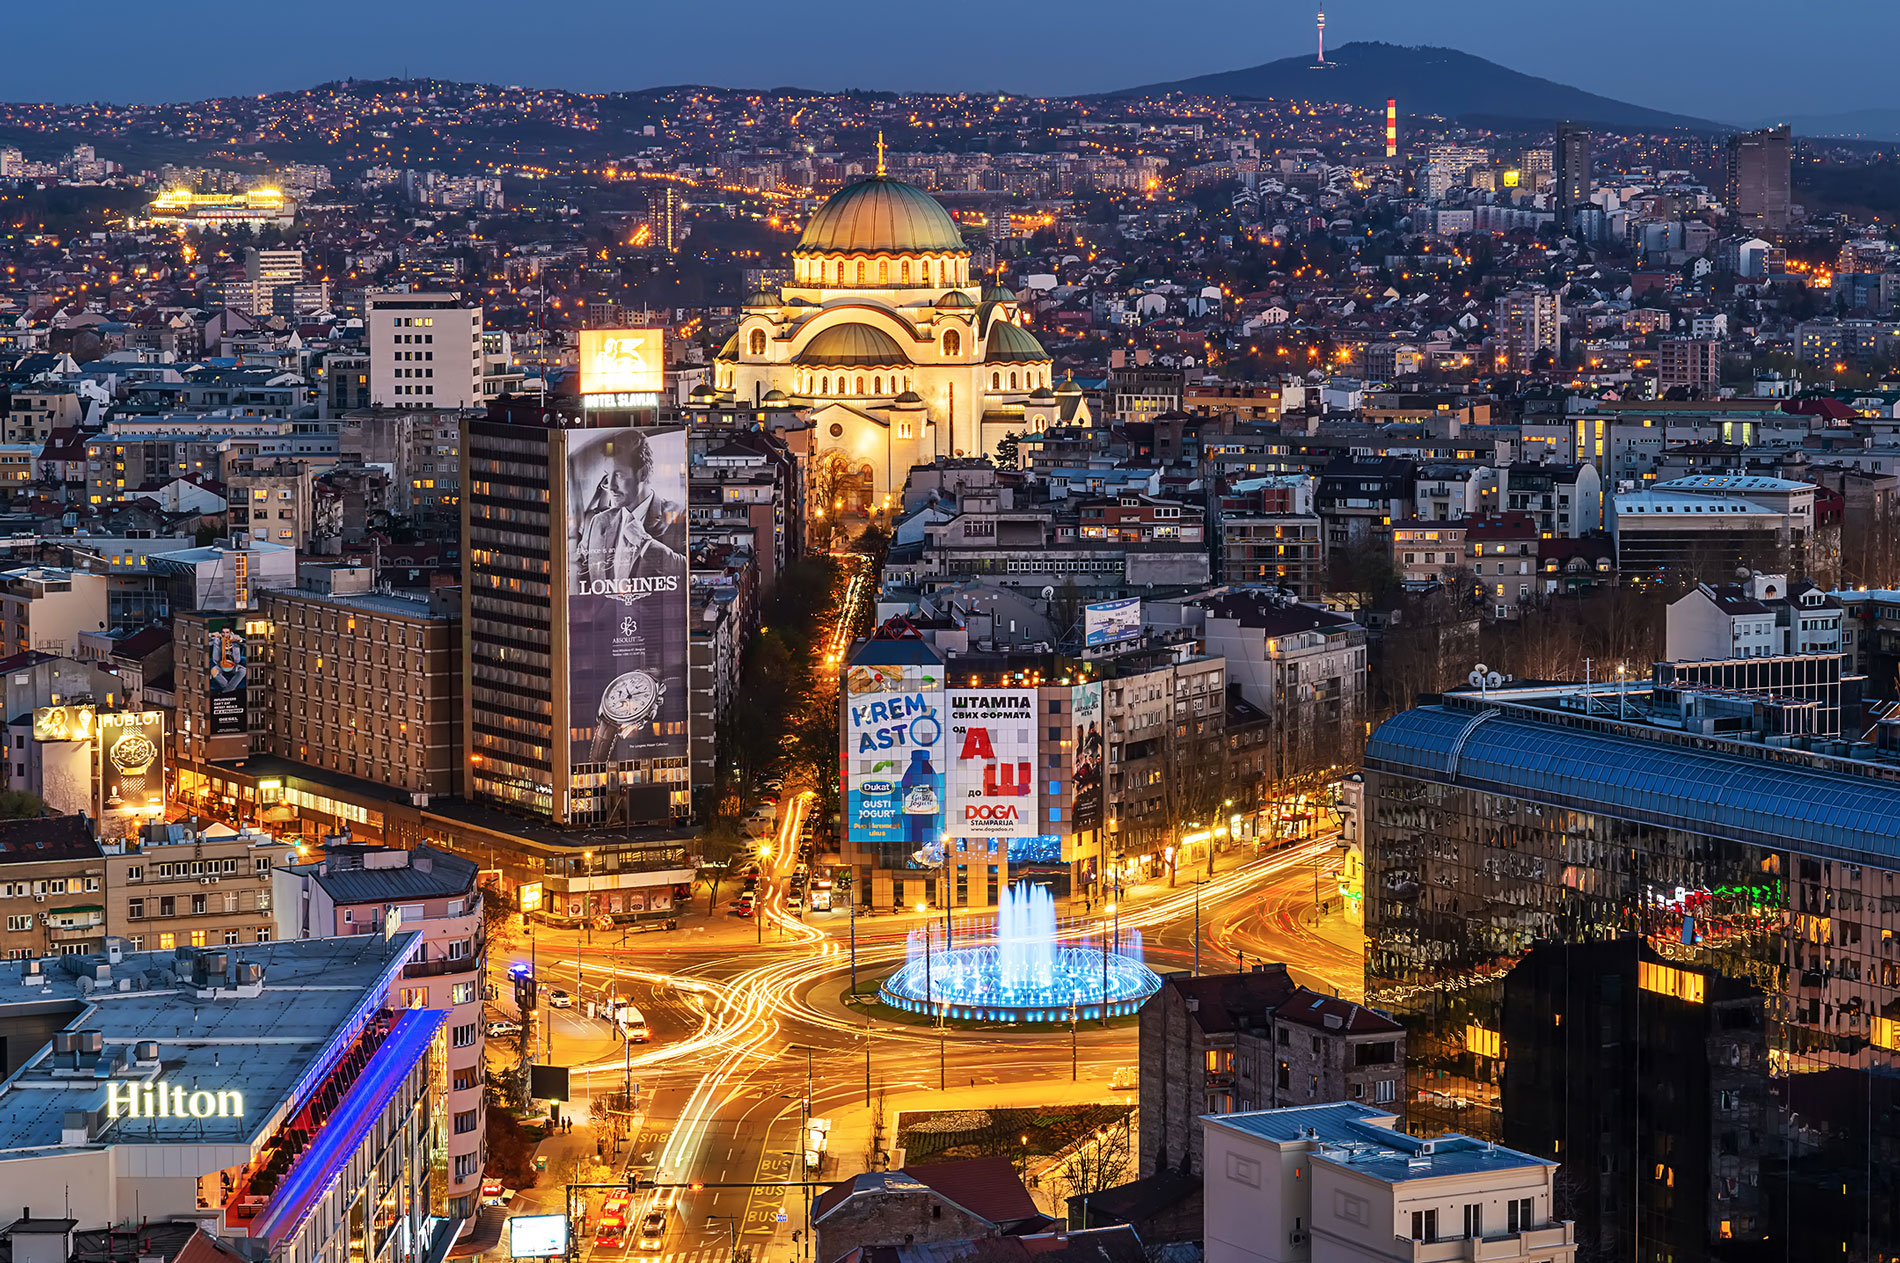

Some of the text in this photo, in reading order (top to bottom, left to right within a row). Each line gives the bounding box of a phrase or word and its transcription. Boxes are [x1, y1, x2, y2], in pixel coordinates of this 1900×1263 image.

[584, 392, 657, 408] HOTEL SLAVIJA
[579, 575, 678, 596] LONGINES
[952, 696, 1031, 709] ШТАМПА
[852, 693, 927, 727] KREM
[952, 711, 1031, 719] СВИХ ФОРМАТА
[103, 713, 160, 728] HUBLOT
[983, 762, 1031, 797] Ш
[863, 783, 890, 791] Dukat
[862, 800, 891, 808] GUSTI
[858, 809, 896, 819] JOGURT
[106, 1081, 245, 1118] Hilton
[760, 1159, 792, 1171] BUS
[754, 1185, 785, 1196] BUS
[747, 1211, 778, 1223] BUS
